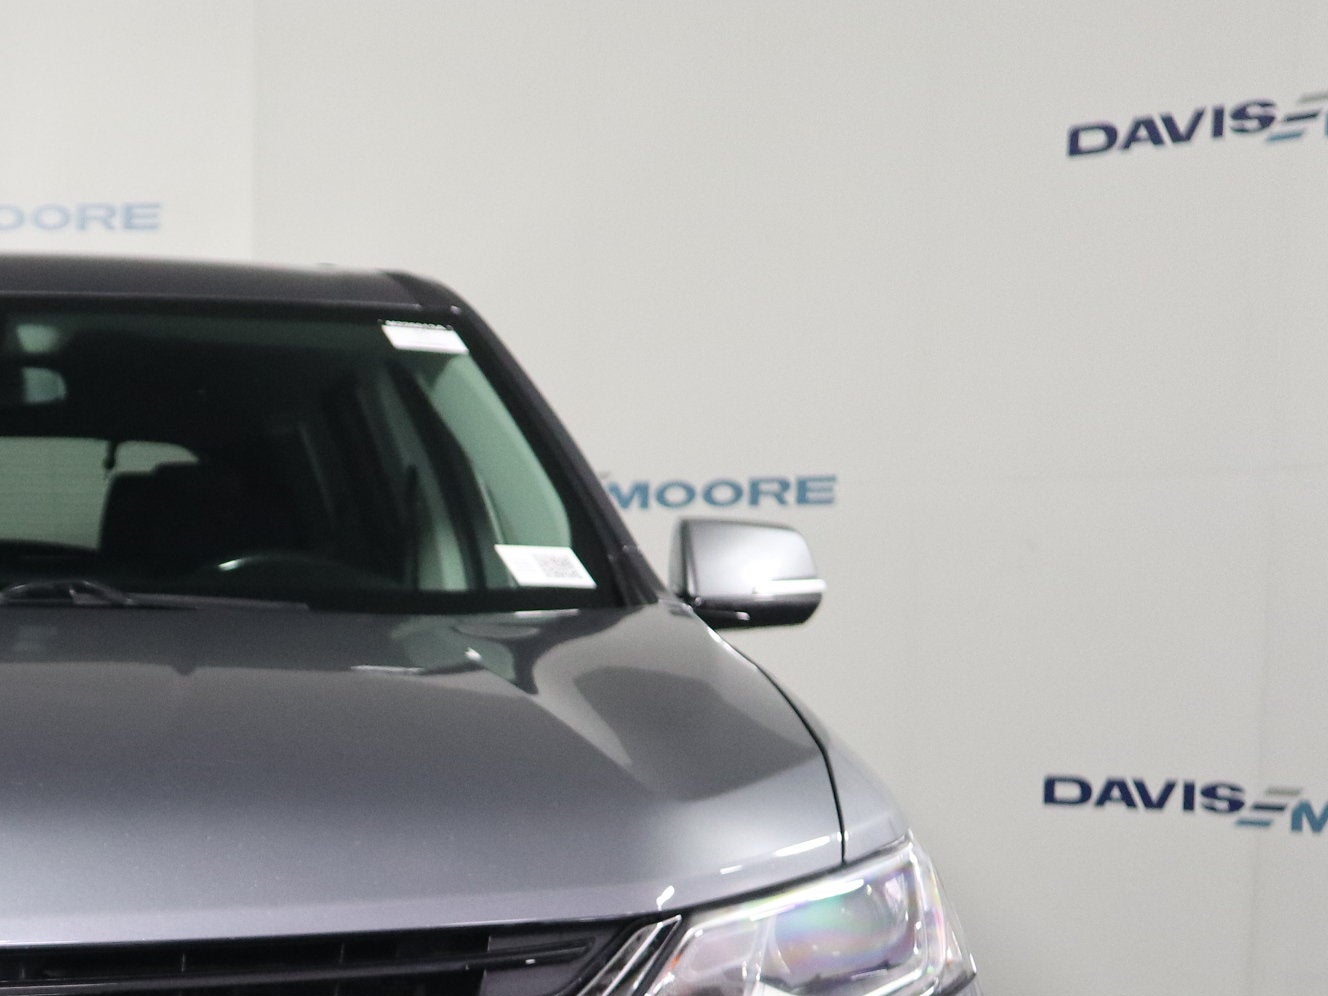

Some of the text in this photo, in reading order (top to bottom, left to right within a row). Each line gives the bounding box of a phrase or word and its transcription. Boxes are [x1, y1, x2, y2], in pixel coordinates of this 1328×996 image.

[1066, 98, 1277, 157] DAVIS
[605, 474, 837, 509] MOORE
[1042, 774, 1246, 815] DAVIS
